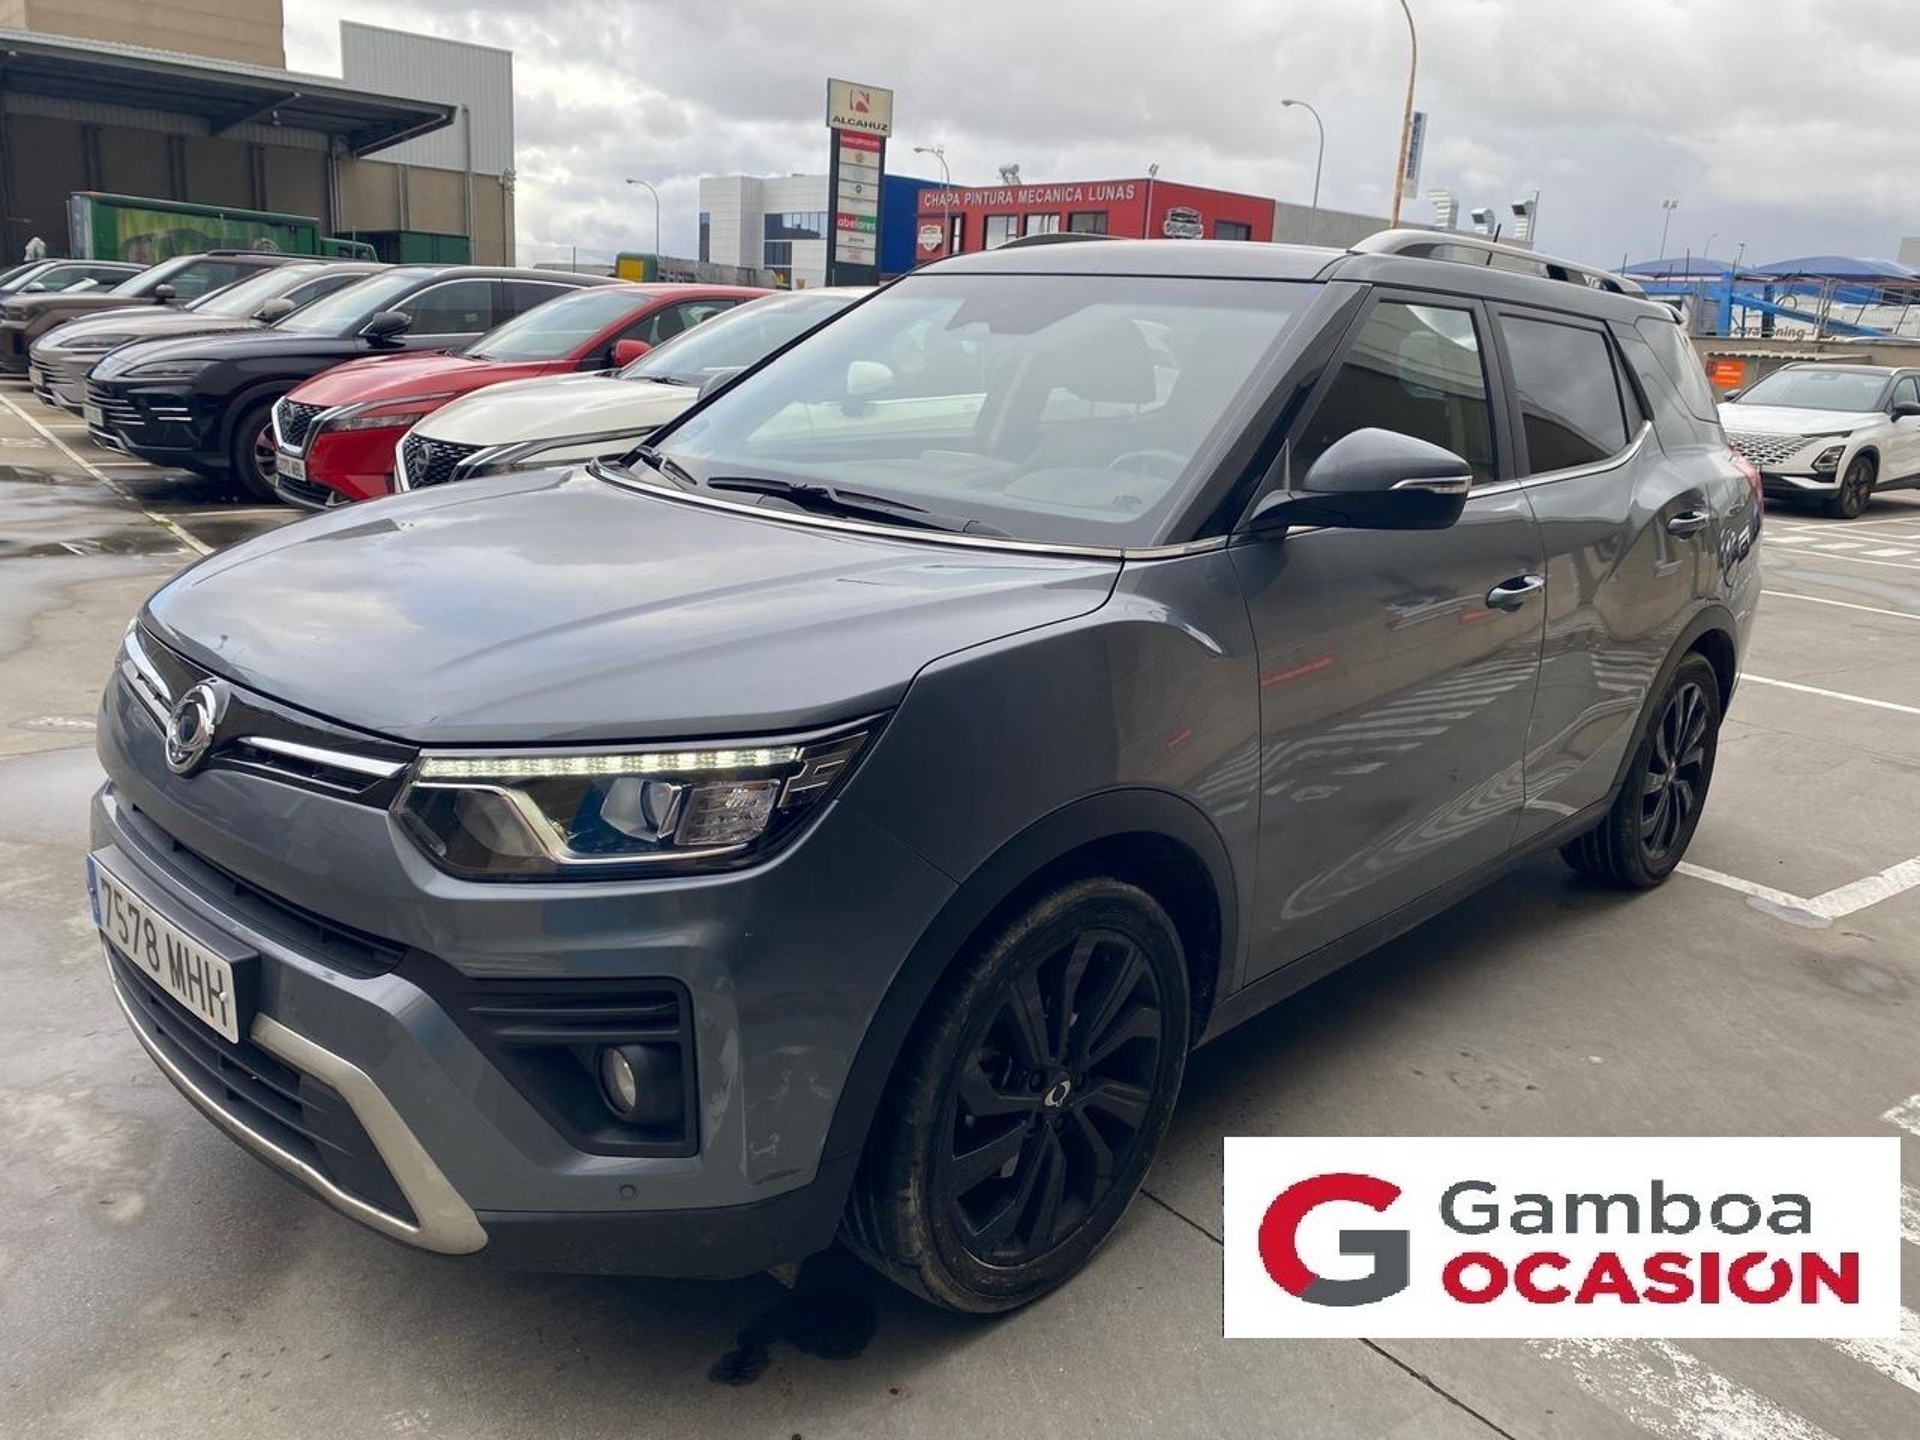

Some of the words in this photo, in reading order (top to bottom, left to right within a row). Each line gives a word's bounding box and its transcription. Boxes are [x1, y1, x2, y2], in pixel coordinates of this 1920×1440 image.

[924, 192, 961, 207] CHAPA
[964, 189, 1014, 206] PINTURA
[1018, 187, 1083, 204] MECANICA
[1088, 184, 1135, 202] LUNAS
[101, 878, 160, 973] 7578
[166, 933, 228, 1027] MHH
